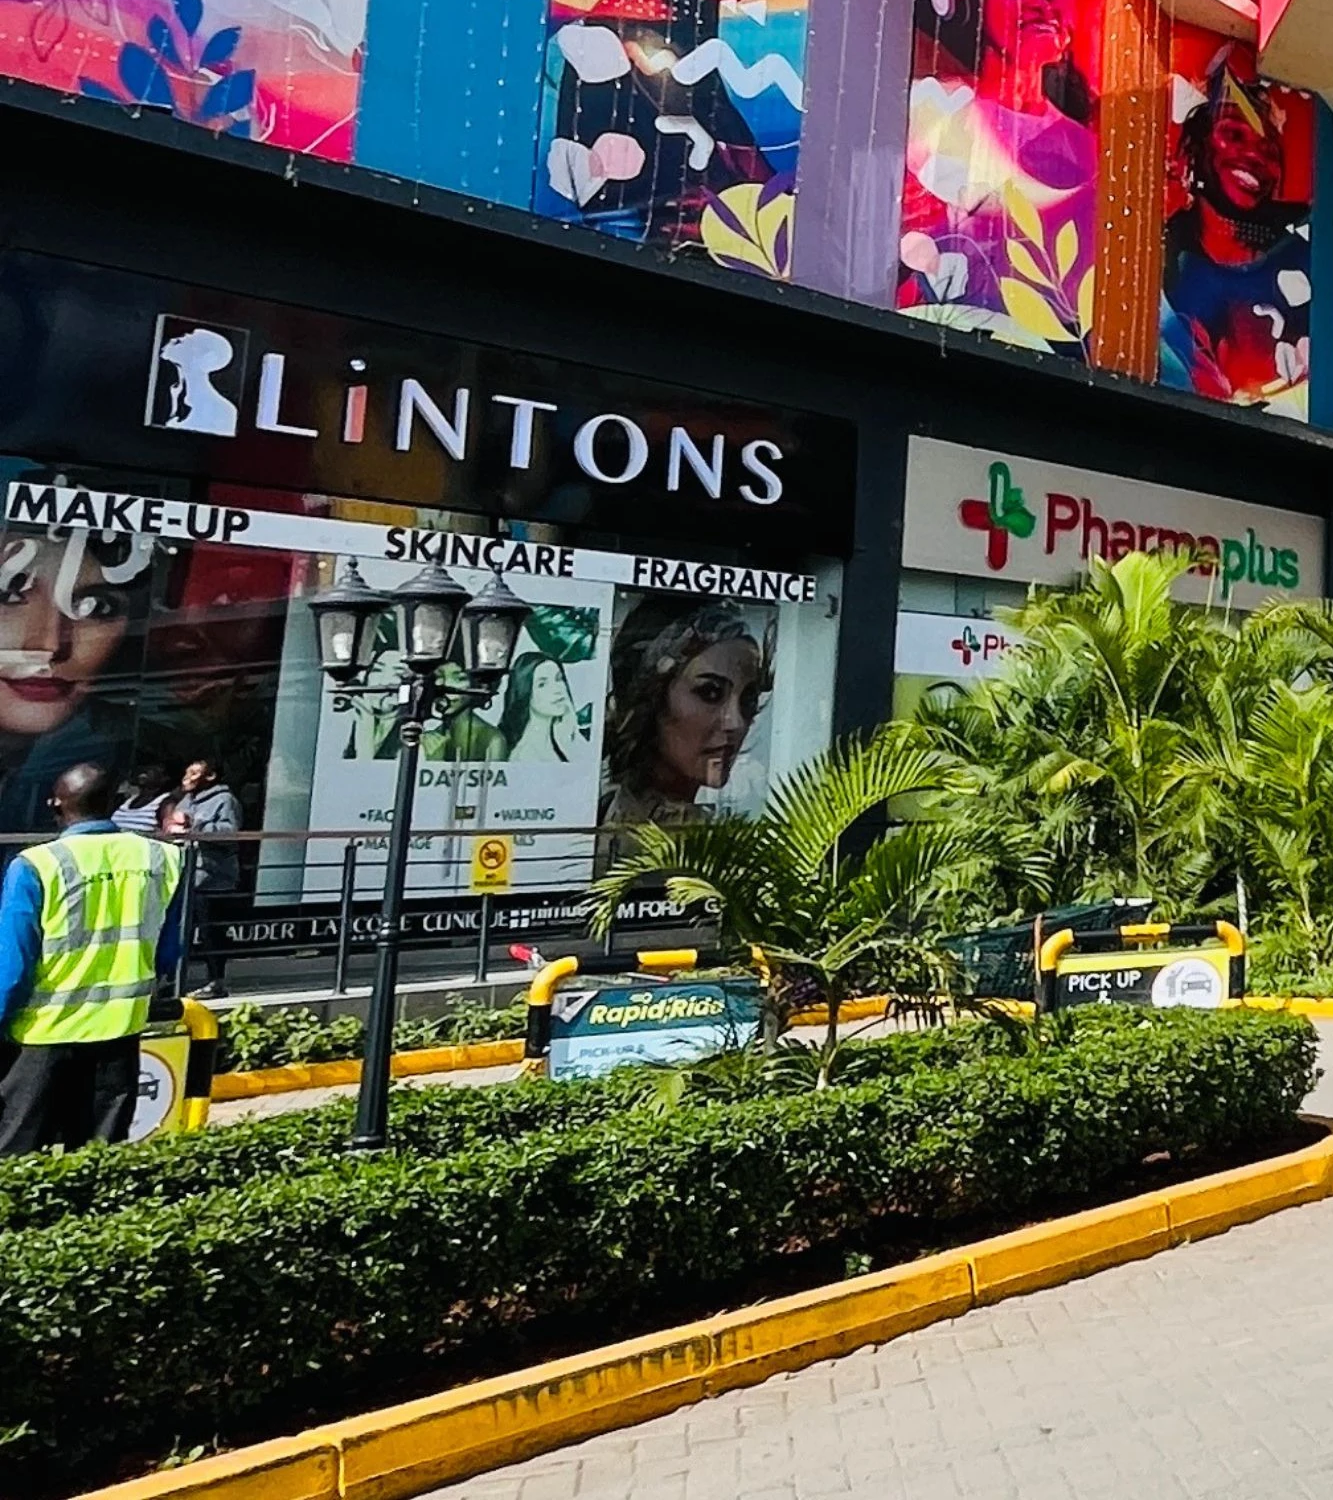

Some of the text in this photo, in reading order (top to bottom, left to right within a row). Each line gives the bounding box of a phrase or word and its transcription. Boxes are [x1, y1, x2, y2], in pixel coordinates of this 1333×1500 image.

[9, 484, 250, 543] MAKE-UP
[386, 529, 575, 576] SKINCARE
[633, 557, 816, 602] FRAGRANCE
[467, 769, 508, 787] SPA
[502, 808, 555, 821] WAXING
[226, 922, 295, 943] AUDER
[638, 901, 686, 918] FORD
[1068, 970, 1142, 992] PICK UP
